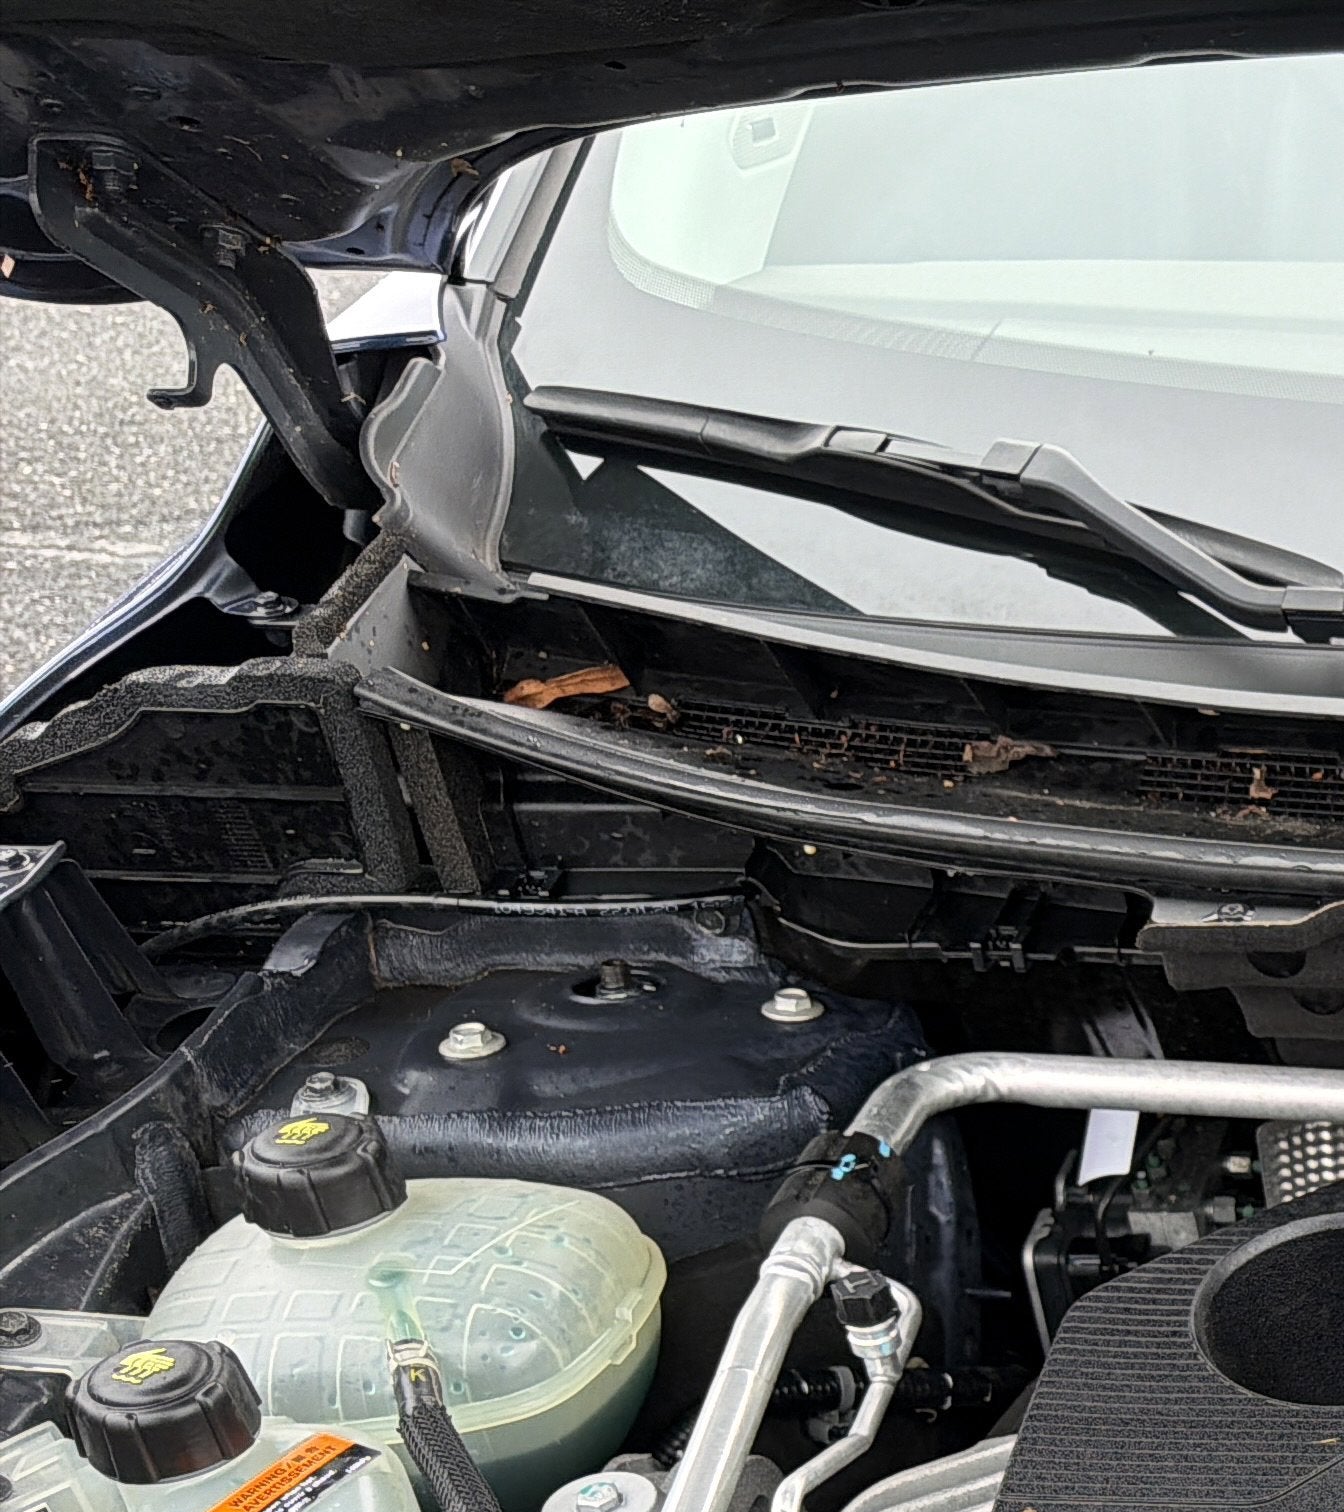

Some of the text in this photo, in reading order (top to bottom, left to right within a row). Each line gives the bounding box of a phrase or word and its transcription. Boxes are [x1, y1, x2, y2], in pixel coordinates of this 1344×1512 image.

[410, 1368, 427, 1382] K
[228, 1467, 289, 1508] WARNING
[241, 1445, 337, 1512] AVERTISSEMENT
